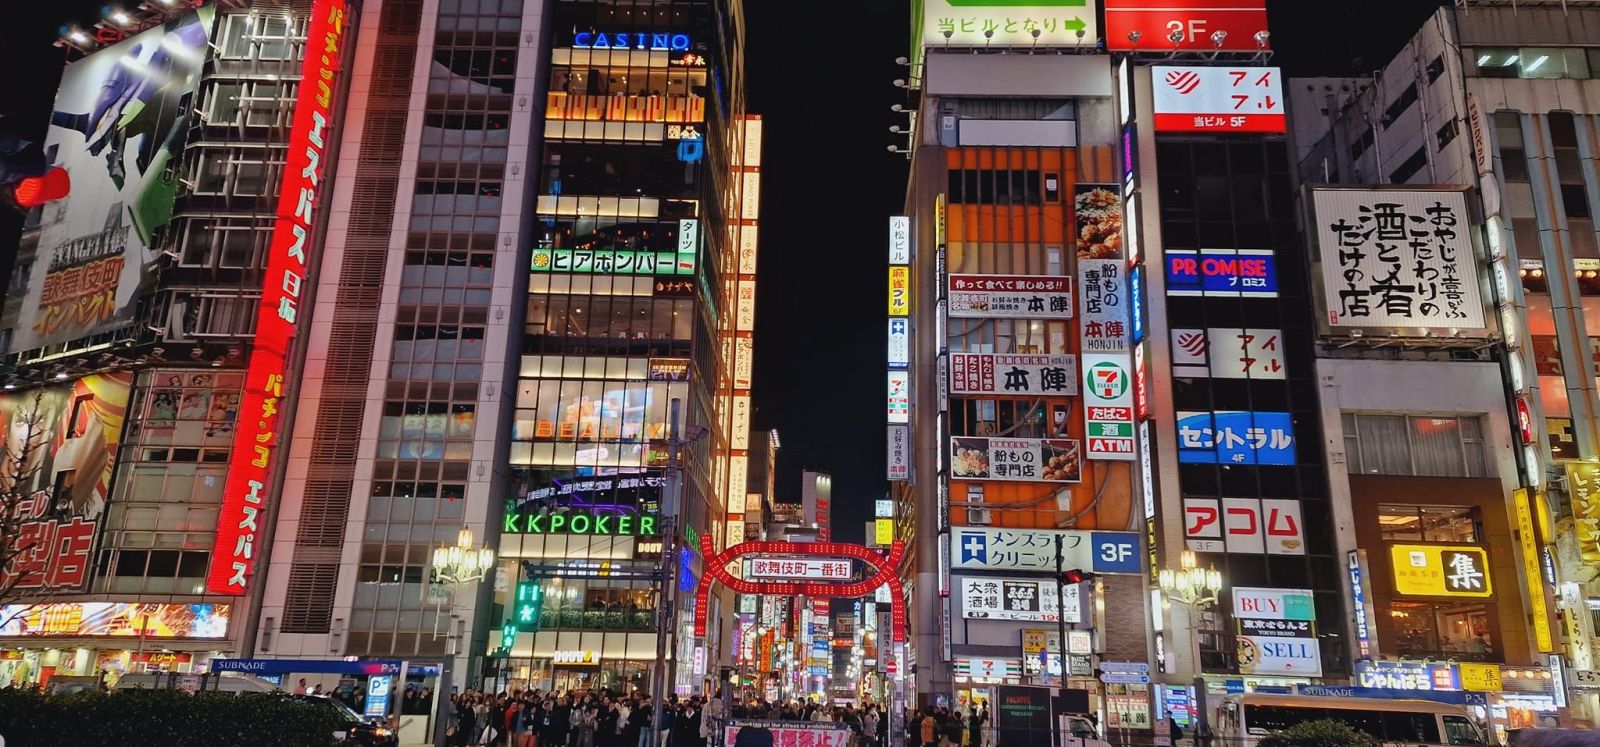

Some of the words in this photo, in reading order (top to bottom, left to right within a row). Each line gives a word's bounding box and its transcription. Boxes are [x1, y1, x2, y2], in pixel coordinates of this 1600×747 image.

[938, 17, 1057, 33] 当ビルとなり
[1166, 19, 1207, 43] 3F
[574, 31, 691, 49] CASINO
[1229, 71, 1271, 87] アイ
[1193, 116, 1225, 127] 当ビル
[1230, 116, 1246, 127] 5F
[291, 110, 326, 265] エスパス
[682, 222, 693, 250] ダーツ
[893, 218, 905, 261] 小松ビル
[552, 251, 675, 271] ビアポンバー
[1171, 257, 1267, 277] PROMISE
[1330, 219, 1370, 317] だけの店
[1358, 204, 1413, 318] 酒と肴
[1408, 215, 1438, 317] こだわりの
[1424, 202, 1465, 319] おやじが喜ぶ
[39, 256, 125, 306] 歌舞伎町
[1101, 263, 1119, 307] 粉もの
[1229, 276, 1267, 287] プロミス
[278, 269, 303, 324] 日拓
[1084, 269, 1102, 313] 専門店
[32, 290, 116, 336] インパクト
[1027, 295, 1068, 312] 本陣
[1084, 320, 1124, 339] 本陣
[1088, 339, 1124, 350] HONJIN
[1004, 366, 1069, 391] 本陣
[1092, 407, 1128, 420] たばこ
[1101, 424, 1119, 436] 酒
[1179, 425, 1293, 450] セントラル
[894, 428, 902, 465] お好み焼き
[994, 449, 1034, 463] 粉もの
[1092, 440, 1132, 453] ATM
[1231, 453, 1245, 462] 4F
[994, 464, 1035, 477] 専門店
[504, 514, 655, 535] KKPOKER
[1186, 506, 1299, 537] アコム
[228, 479, 264, 588] エスパス
[1101, 543, 1133, 563] 3F
[1196, 541, 1212, 550] 3F
[754, 561, 848, 577] 歌舞伎町一番街
[1447, 553, 1484, 589] 集
[968, 581, 999, 594] 大衆
[968, 595, 999, 608] 酒場
[1241, 597, 1281, 613] BUY
[1263, 643, 1313, 659] SELL
[219, 661, 266, 670] SUBNADE
[1359, 672, 1431, 691] じゃんぱら
[1577, 671, 1600, 682] とら
[1305, 687, 1355, 697] SUBNADE
